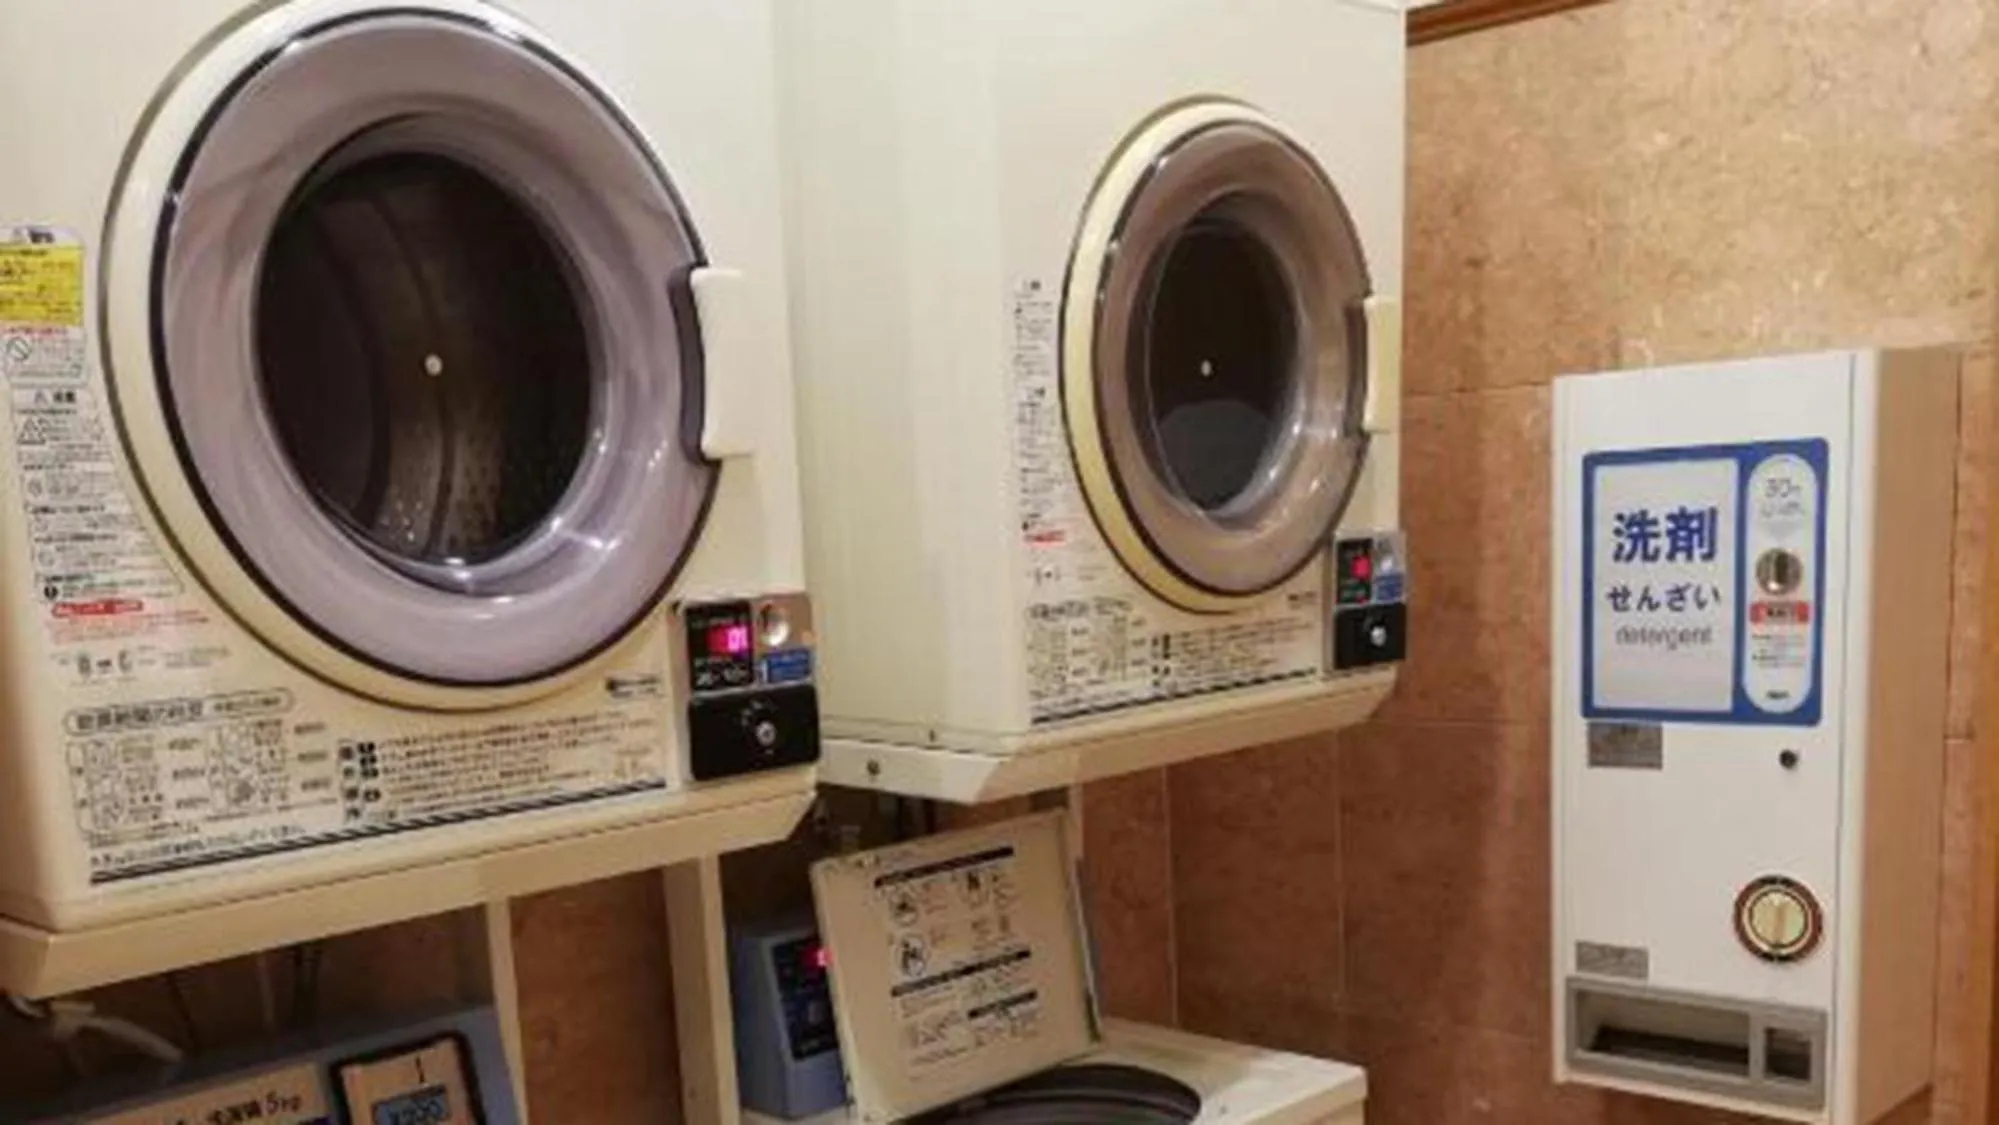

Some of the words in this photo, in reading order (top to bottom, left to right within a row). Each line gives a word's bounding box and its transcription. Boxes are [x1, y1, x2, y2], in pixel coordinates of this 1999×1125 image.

[1613, 506, 1718, 563] 洗剤
[1607, 583, 1721, 612] せんざい
[1615, 624, 1713, 651] detergent
